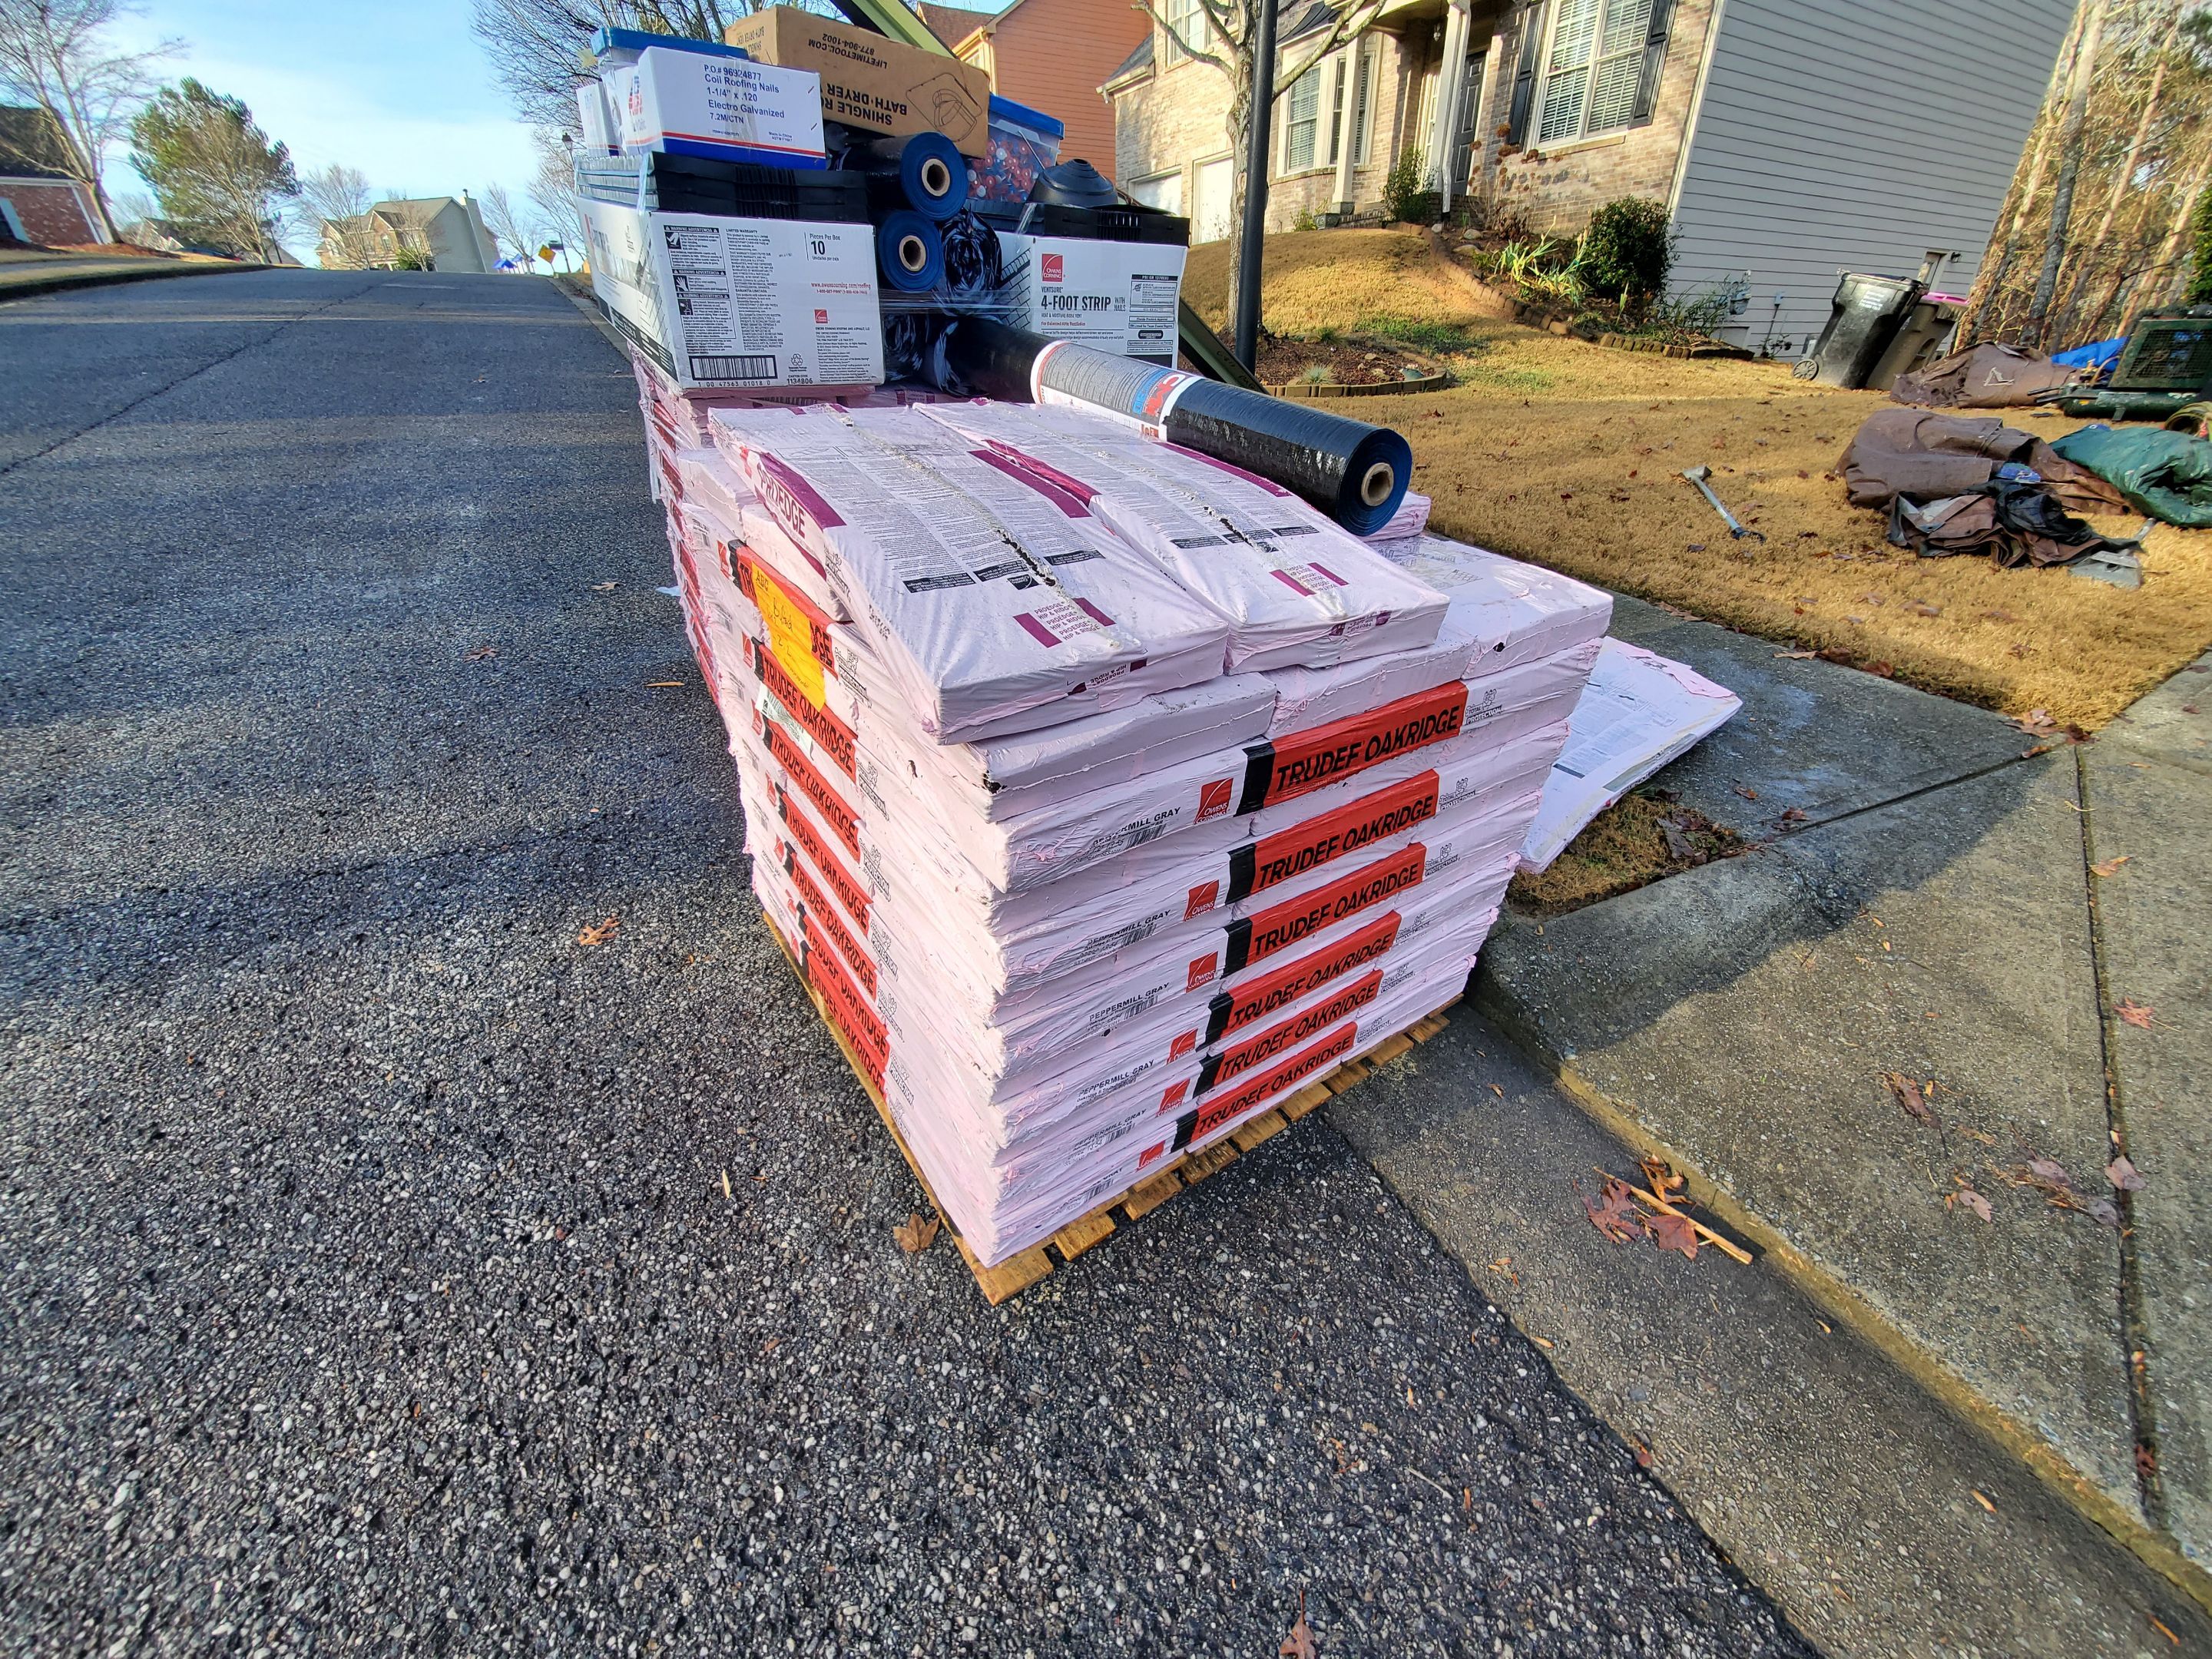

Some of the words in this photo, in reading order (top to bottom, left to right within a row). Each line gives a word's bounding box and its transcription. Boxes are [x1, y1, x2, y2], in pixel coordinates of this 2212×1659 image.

[808, 38, 887, 70] LIFETIMETOOL.COM
[822, 33, 875, 56] 877-904-1002
[705, 74, 722, 84] Coil
[724, 76, 757, 91] Roofing
[759, 83, 780, 94] Nails
[724, 68, 761, 81] 96924877
[741, 92, 757, 102] .120
[708, 99, 738, 111] Electro
[740, 104, 785, 118] Galvanized
[710, 112, 744, 124] 7.2M/CTN
[836, 102, 893, 125] SHINGLE
[810, 240, 826, 255] 10
[1041, 295, 1079, 311] 4-FOOT
[1081, 296, 1111, 312] STRIP
[1034, 602, 1063, 614] PROEDGE
[1038, 611, 1048, 620] HIP
[1081, 624, 1101, 634] RIDGE
[764, 659, 797, 711] TRUDEF
[799, 695, 853, 773] OAKRIDGE
[1465, 704, 1482, 717] TOTAL
[1466, 705, 1502, 725] PROTECTION
[1276, 743, 1362, 791] TRUDEF
[1365, 706, 1461, 762] OAKRIDGE
[1154, 807, 1181, 821] GRAY
[1196, 810, 1227, 824] CORNING
[1204, 803, 1229, 816] OWENS
[1258, 835, 1339, 888] TRUDEF
[1343, 796, 1434, 851] OAKRIDGE
[1145, 909, 1171, 924] GRAY
[1192, 902, 1214, 915] OWENS
[1254, 902, 1331, 956] TRUDEF
[1333, 863, 1419, 918] OAKRIDGE
[795, 866, 826, 916] TRUDEF
[826, 911, 875, 997] OAKRIDGE
[1230, 977, 1306, 1028] TRUDEF
[1306, 933, 1393, 990] OAKRIDGE
[1089, 990, 1143, 1022] PEPPERMILL
[1145, 982, 1170, 996] GRAY
[1222, 1025, 1294, 1080] TRUDEF
[1295, 982, 1377, 1038] OAKRIDGE
[889, 1062, 915, 1105] PROTECTION
[1078, 1071, 1130, 1097] PEPPERMILL
[1132, 1059, 1154, 1074] GRAY
[1200, 1082, 1269, 1134] TRUDEF
[1270, 1035, 1351, 1093] OAKRIDGE
[1124, 1108, 1147, 1123] GRAY
